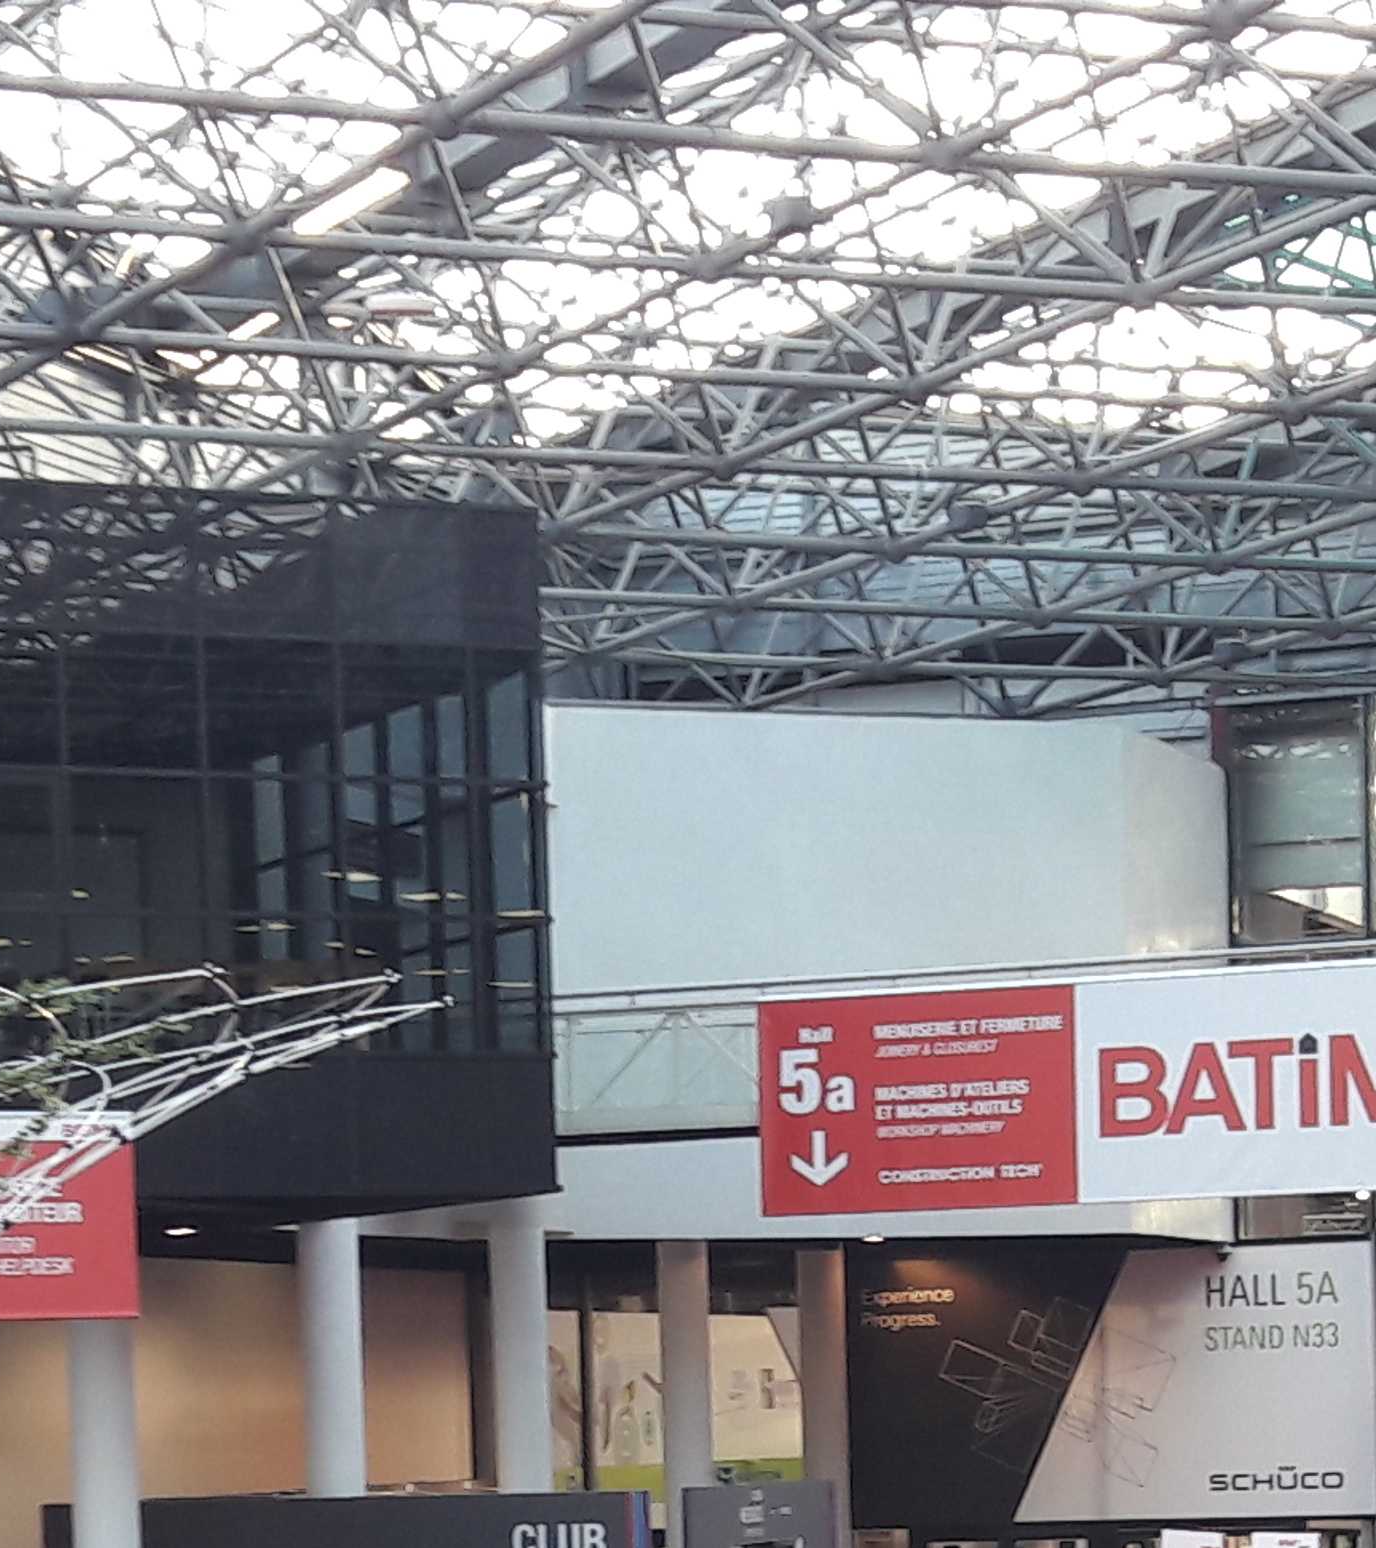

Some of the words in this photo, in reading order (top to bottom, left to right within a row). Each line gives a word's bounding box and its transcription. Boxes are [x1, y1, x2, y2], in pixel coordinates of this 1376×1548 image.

[778, 1048, 856, 1115] 5a
[1205, 1274, 1286, 1307] HALL
[1296, 1271, 1339, 1304] 5A
[1204, 1325, 1284, 1350] STAND
[1293, 1322, 1339, 1348] N33
[1209, 1466, 1344, 1491] SCHÜCO
